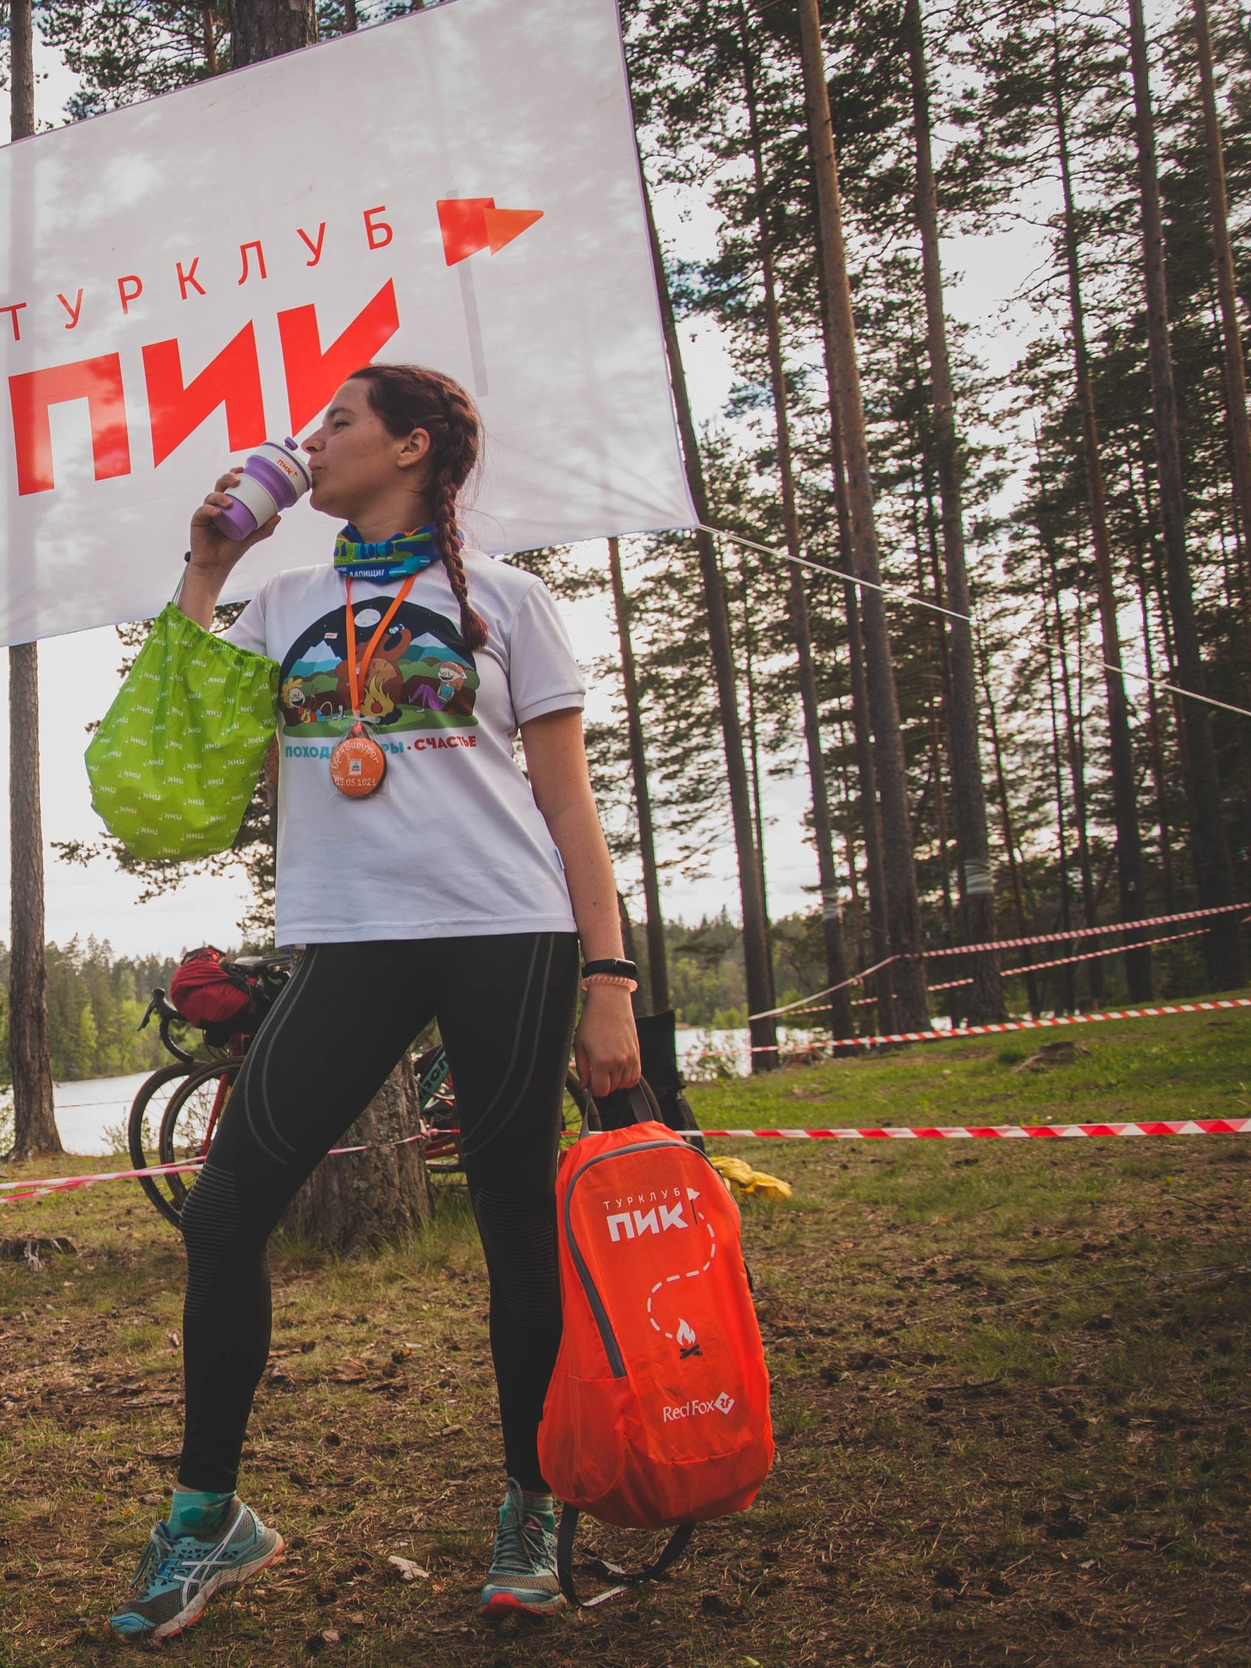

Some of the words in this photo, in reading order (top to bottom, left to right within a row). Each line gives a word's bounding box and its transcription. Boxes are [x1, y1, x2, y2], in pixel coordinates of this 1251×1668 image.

[0, 205, 394, 341] ТУРКЛУБ
[8, 277, 400, 496] ПИК
[276, 458, 293, 476] ПИК
[136, 704, 154, 714] ПИК
[205, 710, 222, 718] ПИК
[130, 736, 147, 746] ПИК
[285, 745, 334, 760] ПОХОД
[413, 735, 477, 751] СЧАСТЬЕ
[343, 740, 380, 764] Summer
[124, 770, 141, 779] ПИК
[168, 776, 184, 784] ПИК
[206, 778, 224, 786] ПИК
[100, 785, 116, 794] ПИК
[142, 792, 162, 801] ПИК
[120, 806, 137, 814] ПИК
[164, 812, 182, 820] ПИК
[140, 827, 158, 836] ПИК
[162, 847, 180, 855] ПИК
[603, 1187, 681, 1210] ТУРКЛУБ
[606, 1201, 689, 1242] ПИК
[663, 1402, 690, 1423] Red
[691, 1400, 715, 1416] Fox
